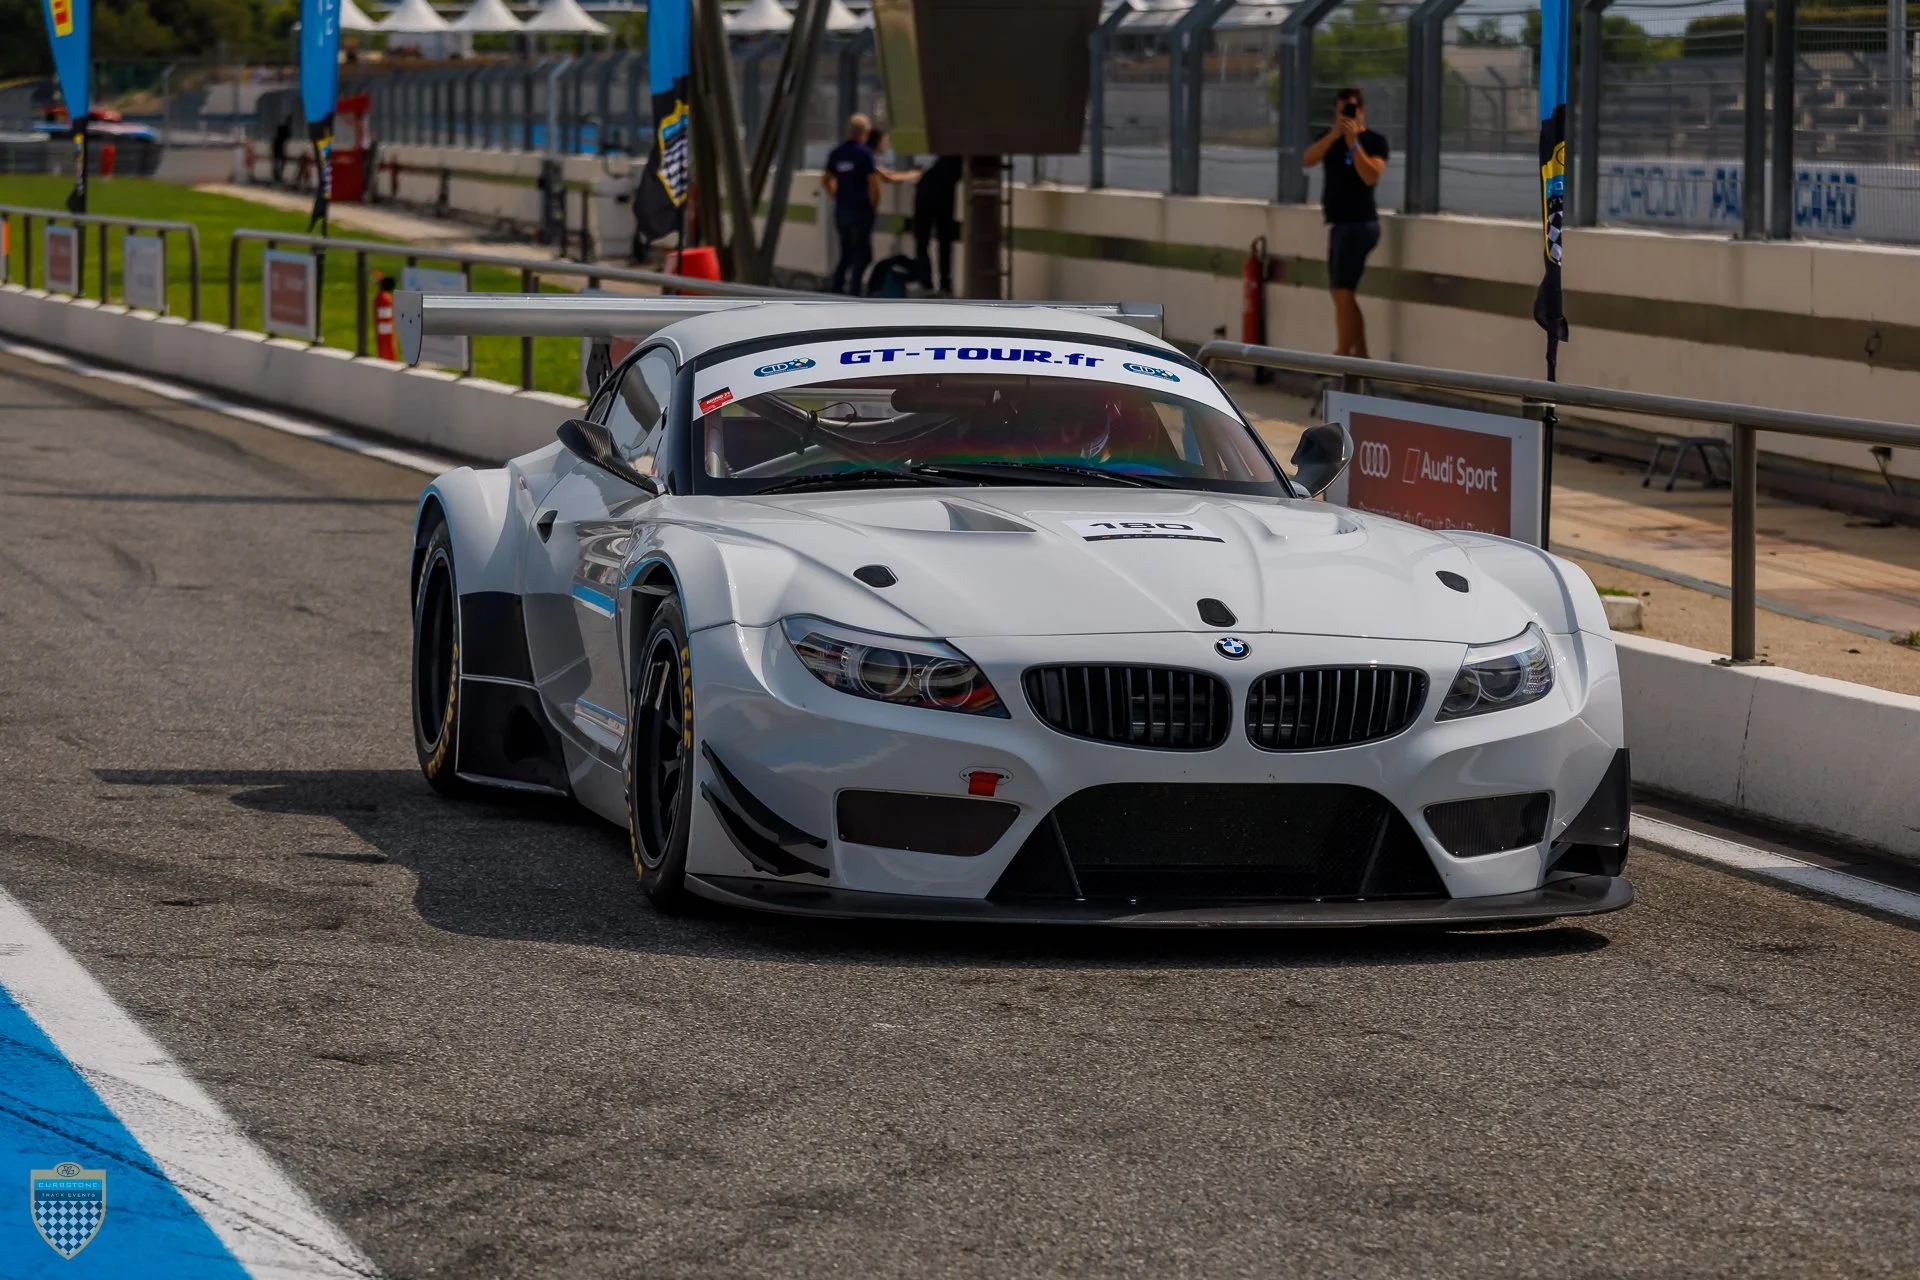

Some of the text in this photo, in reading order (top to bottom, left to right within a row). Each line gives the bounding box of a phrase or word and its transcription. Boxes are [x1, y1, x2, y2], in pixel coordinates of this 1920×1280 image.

[840, 347, 1104, 367] GT-TOUR.fr
[1421, 451, 1497, 495] Audi Sport
